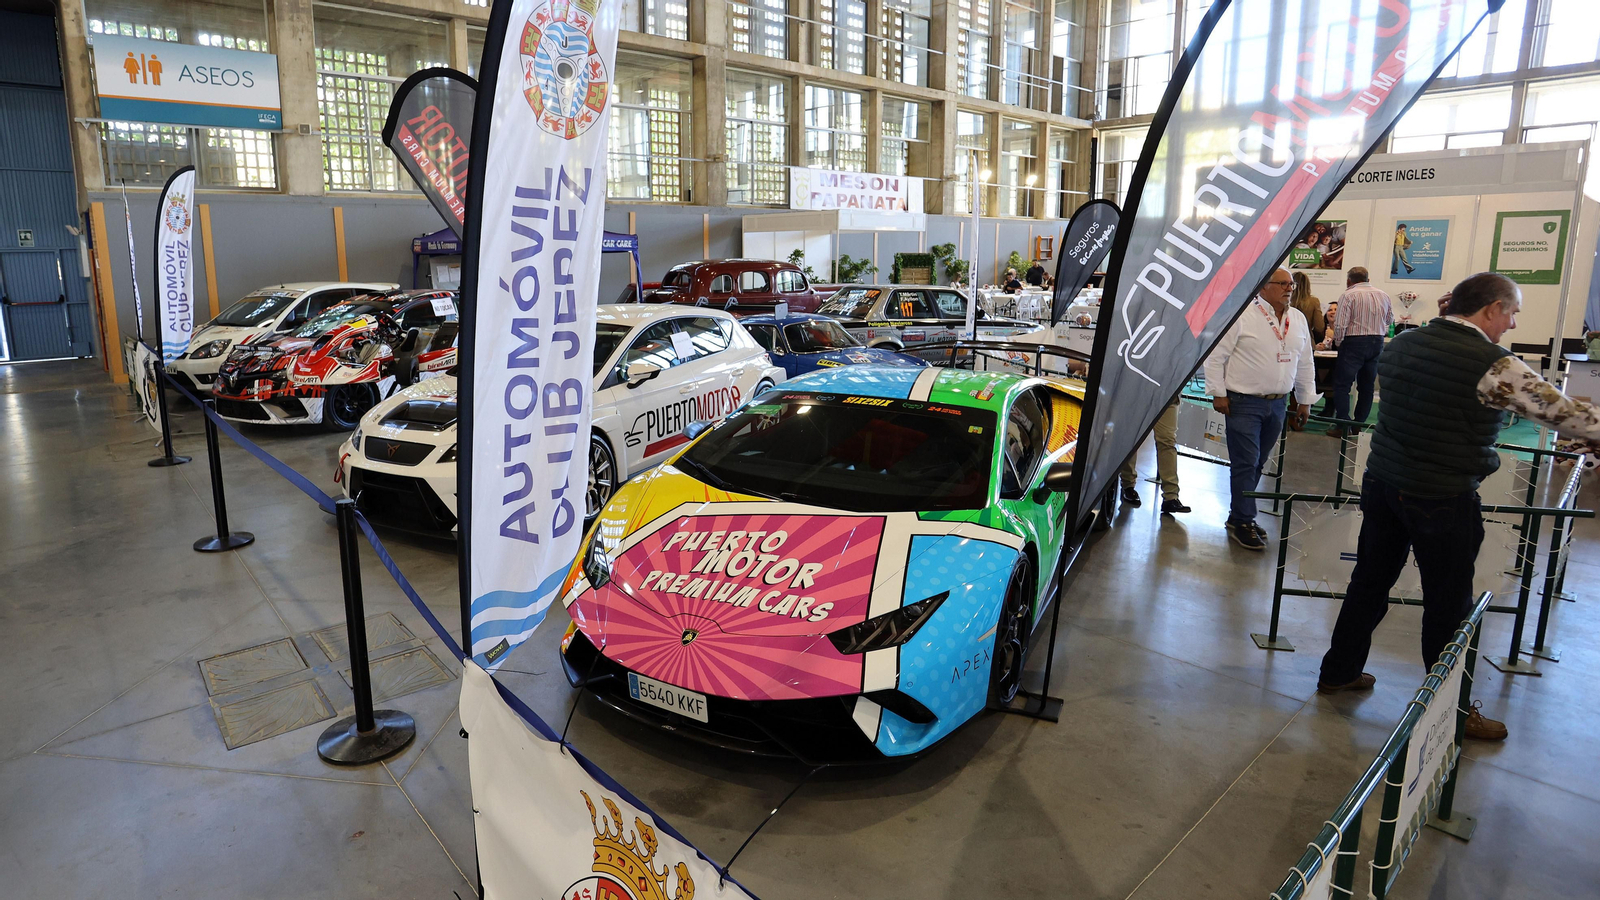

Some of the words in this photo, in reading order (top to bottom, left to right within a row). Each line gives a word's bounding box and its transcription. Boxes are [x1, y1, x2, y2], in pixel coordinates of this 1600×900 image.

[178, 64, 255, 88] ASEOS
[820, 173, 899, 192] MESON
[1357, 171, 1393, 183] CORTE
[1395, 168, 1435, 181] INGLES
[811, 191, 907, 211] PAPANATA
[603, 240, 616, 248] CAR
[616, 239, 632, 248] CARE
[1068, 221, 1100, 258] Seguros
[163, 240, 178, 332] AUTOMÓVIL
[900, 302, 913, 317] 117
[499, 167, 553, 545] AUTOMÓVIL
[842, 396, 894, 407] SIX2SIX
[1204, 419, 1227, 435] IFE
[660, 529, 789, 554] PUERTO
[689, 549, 824, 590] MOTOR
[638, 570, 762, 609] PREMIUM
[758, 590, 835, 622] CARS
[951, 646, 991, 684] APEX
[640, 681, 675, 706] 5540
[677, 693, 704, 715] KKF
